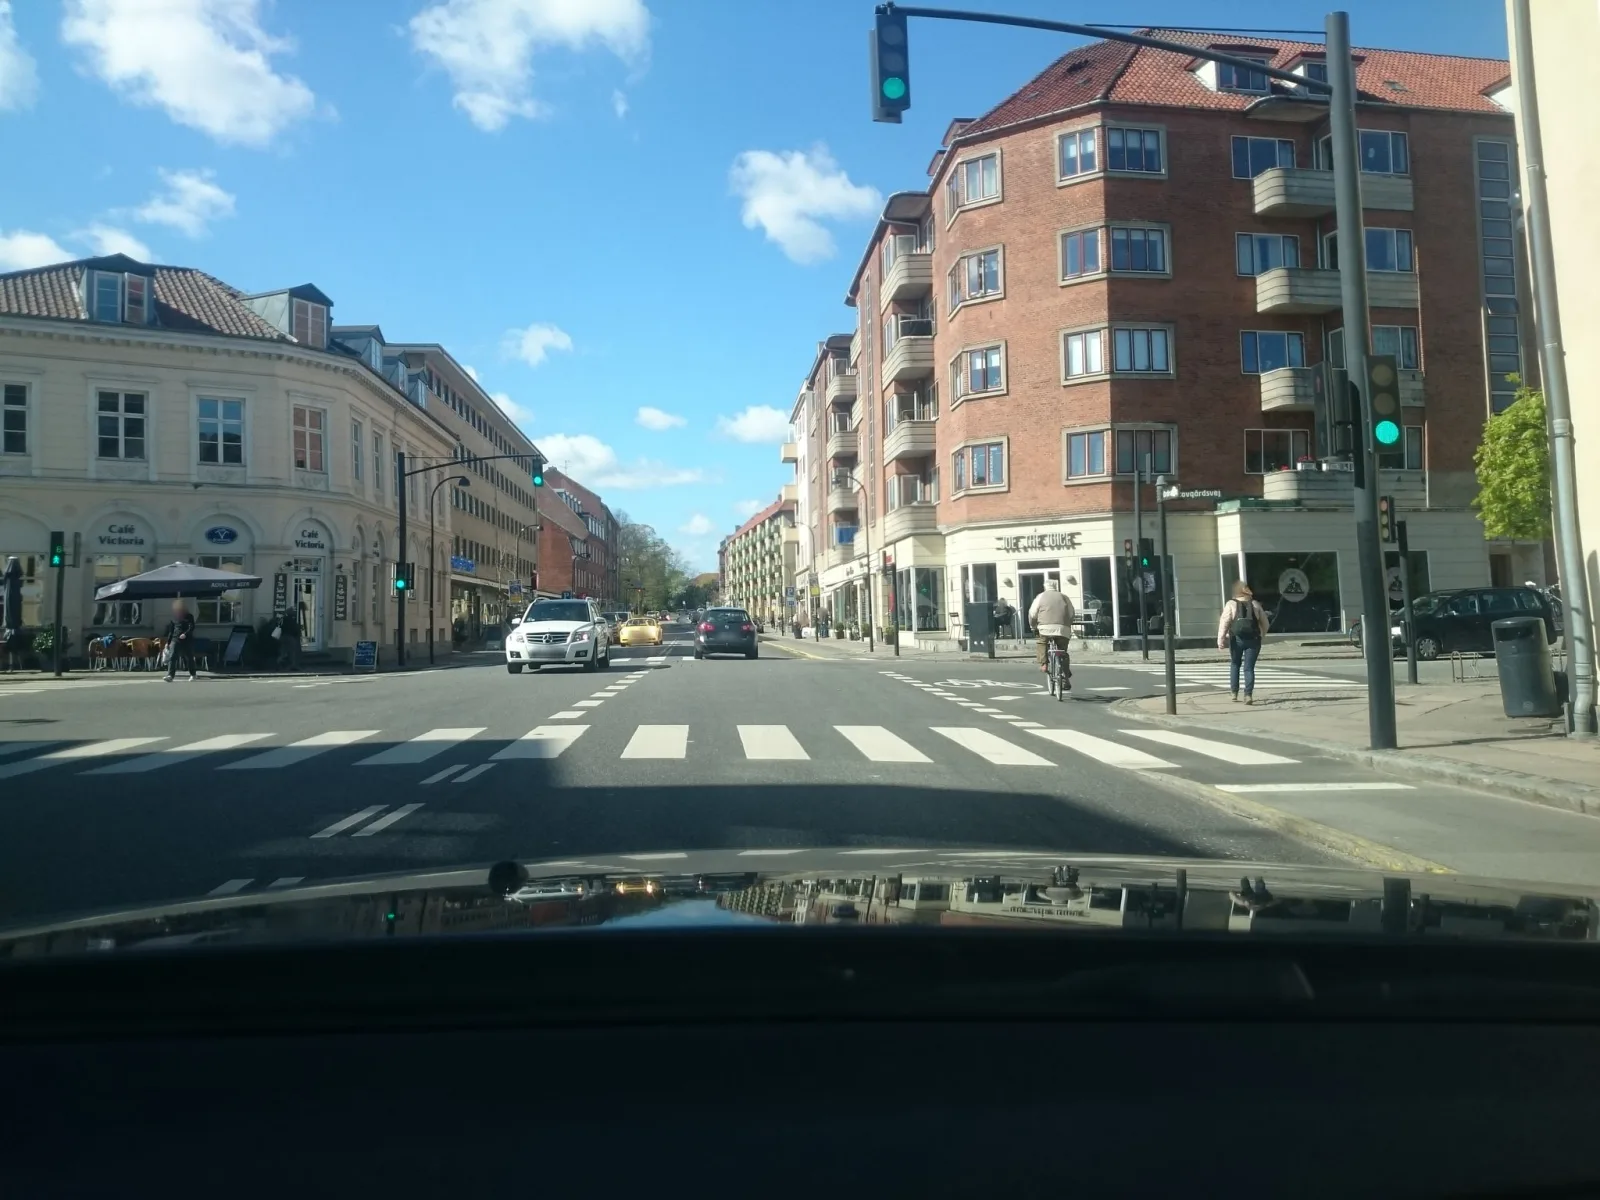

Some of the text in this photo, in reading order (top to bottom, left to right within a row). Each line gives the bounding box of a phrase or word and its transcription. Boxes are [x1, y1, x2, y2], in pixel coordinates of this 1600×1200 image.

[1179, 489, 1221, 499] ovgårdsvej
[108, 524, 136, 534] Café
[302, 530, 319, 539] Café
[98, 535, 145, 545] Victoria
[295, 540, 325, 549] Victoria
